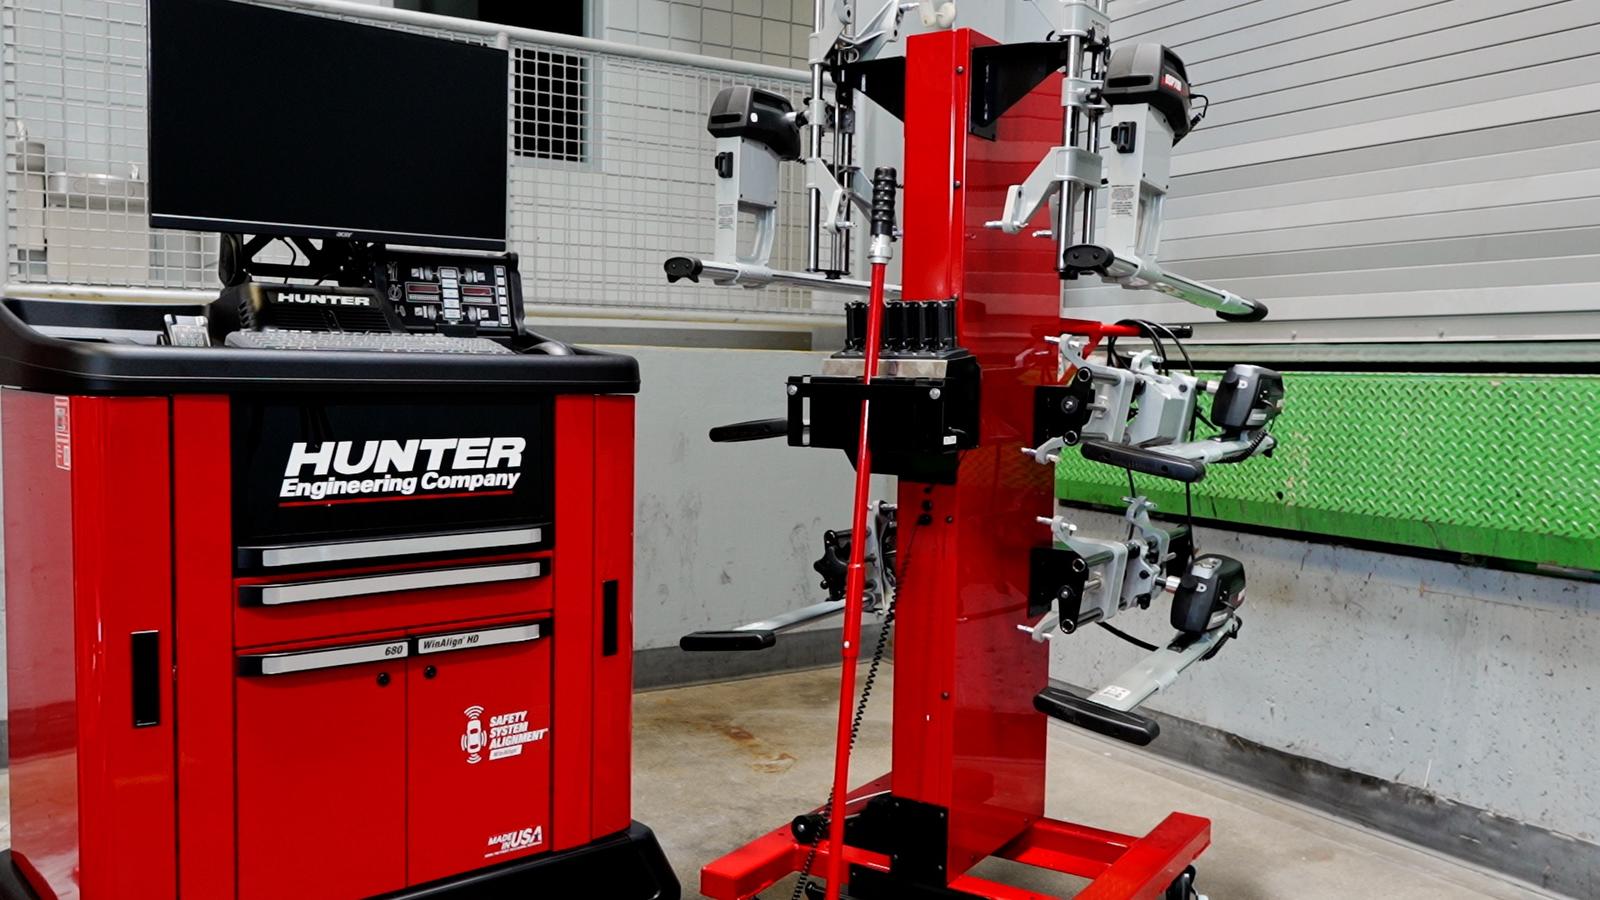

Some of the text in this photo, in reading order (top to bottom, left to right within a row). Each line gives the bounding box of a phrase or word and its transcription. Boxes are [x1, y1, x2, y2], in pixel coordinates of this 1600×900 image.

[277, 292, 370, 306] HUNTER
[284, 437, 527, 477] HUNTER
[279, 472, 521, 500] Engineering Company
[466, 634, 480, 644] HD
[384, 645, 404, 657] 680
[489, 710, 528, 727] SAFETY
[489, 721, 529, 739] SYSTEM
[487, 833, 512, 846] MADE
[510, 825, 543, 848] USA
